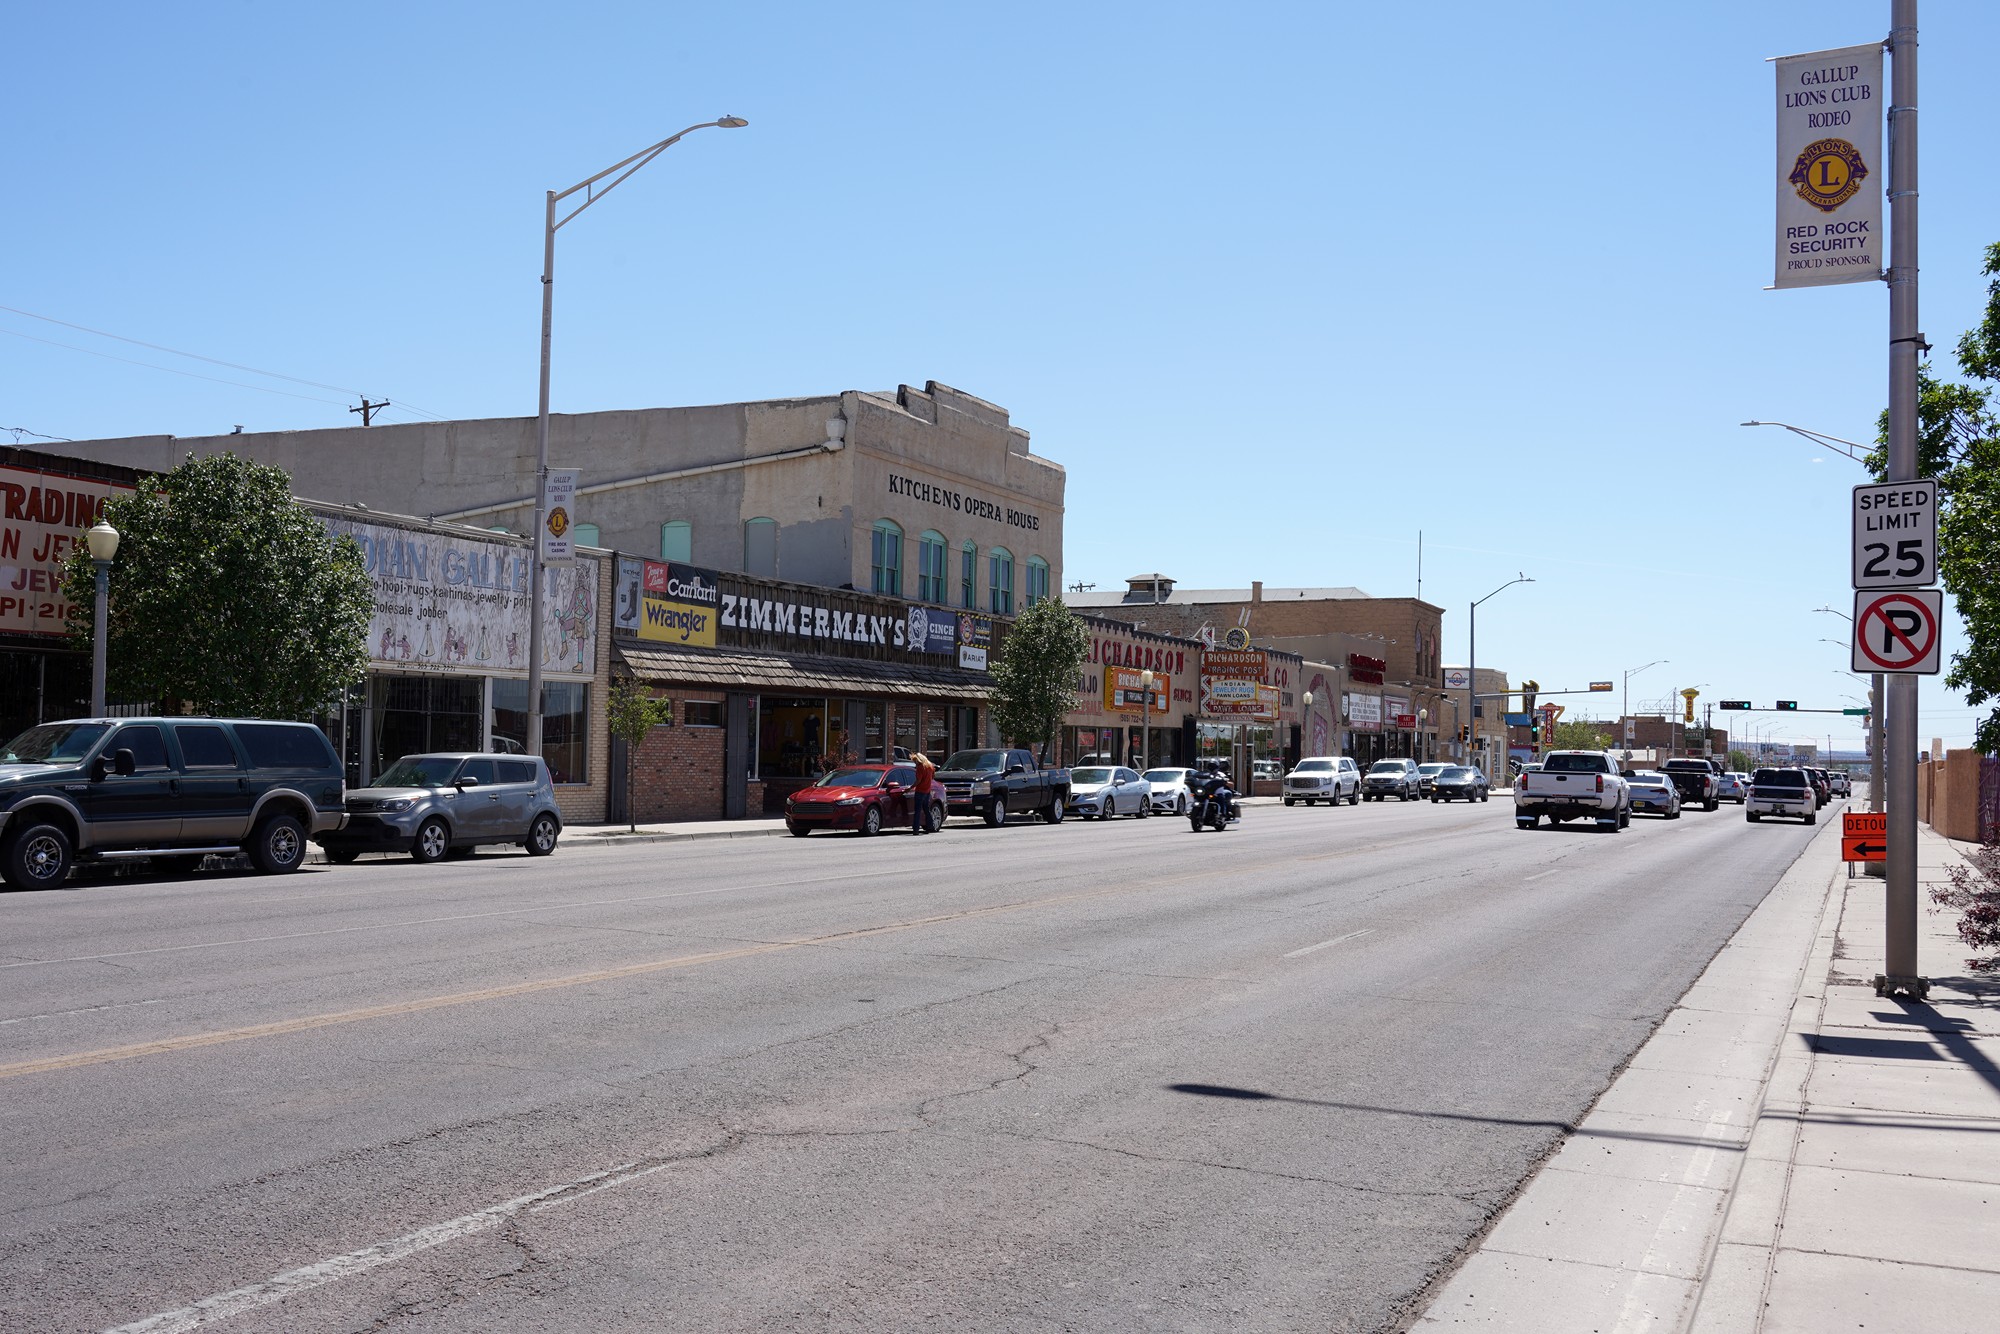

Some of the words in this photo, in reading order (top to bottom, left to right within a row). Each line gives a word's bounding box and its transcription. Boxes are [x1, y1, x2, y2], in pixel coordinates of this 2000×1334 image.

[1801, 65, 1858, 85] GALLUP
[1785, 90, 1827, 108] LIONS
[1831, 85, 1871, 103] CLUB
[1808, 110, 1851, 128] RODEO
[1808, 141, 1849, 158] LIONS
[1818, 161, 1840, 187] L
[1804, 185, 1855, 205] INTERNATIONAL
[1787, 225, 1818, 238] RED
[1825, 221, 1869, 235] ROCK
[1790, 236, 1867, 254] SECURITY
[1788, 259, 1823, 270] PROUD
[1826, 255, 1871, 267] SPONSOR
[889, 474, 961, 511] KITCHENS
[964, 496, 1002, 522] OPERA
[1006, 508, 1039, 530] HOUSE
[1860, 490, 1928, 510] SPEED
[1867, 512, 1921, 531] LIMIT
[353, 533, 427, 581] DIAN
[441, 549, 558, 598] GALLEY
[1863, 540, 1925, 577] 25
[667, 578, 717, 603] Carhartt
[372, 597, 413, 616] holesale
[417, 604, 448, 621] jobber
[645, 601, 707, 641] Wrangler
[721, 594, 905, 646] ZIMMERMAN'S
[929, 623, 955, 636] CINCH
[1883, 609, 1922, 654] P
[967, 654, 985, 663] ARIAT
[1208, 654, 1262, 664] RICHARDSON
[1208, 666, 1240, 674] TRADING
[1243, 666, 1262, 674] POST
[1077, 674, 1098, 694] AJO
[1118, 673, 1163, 691] RICHAON
[1213, 705, 1234, 713] PAWN
[1237, 705, 1262, 713] LOANS
